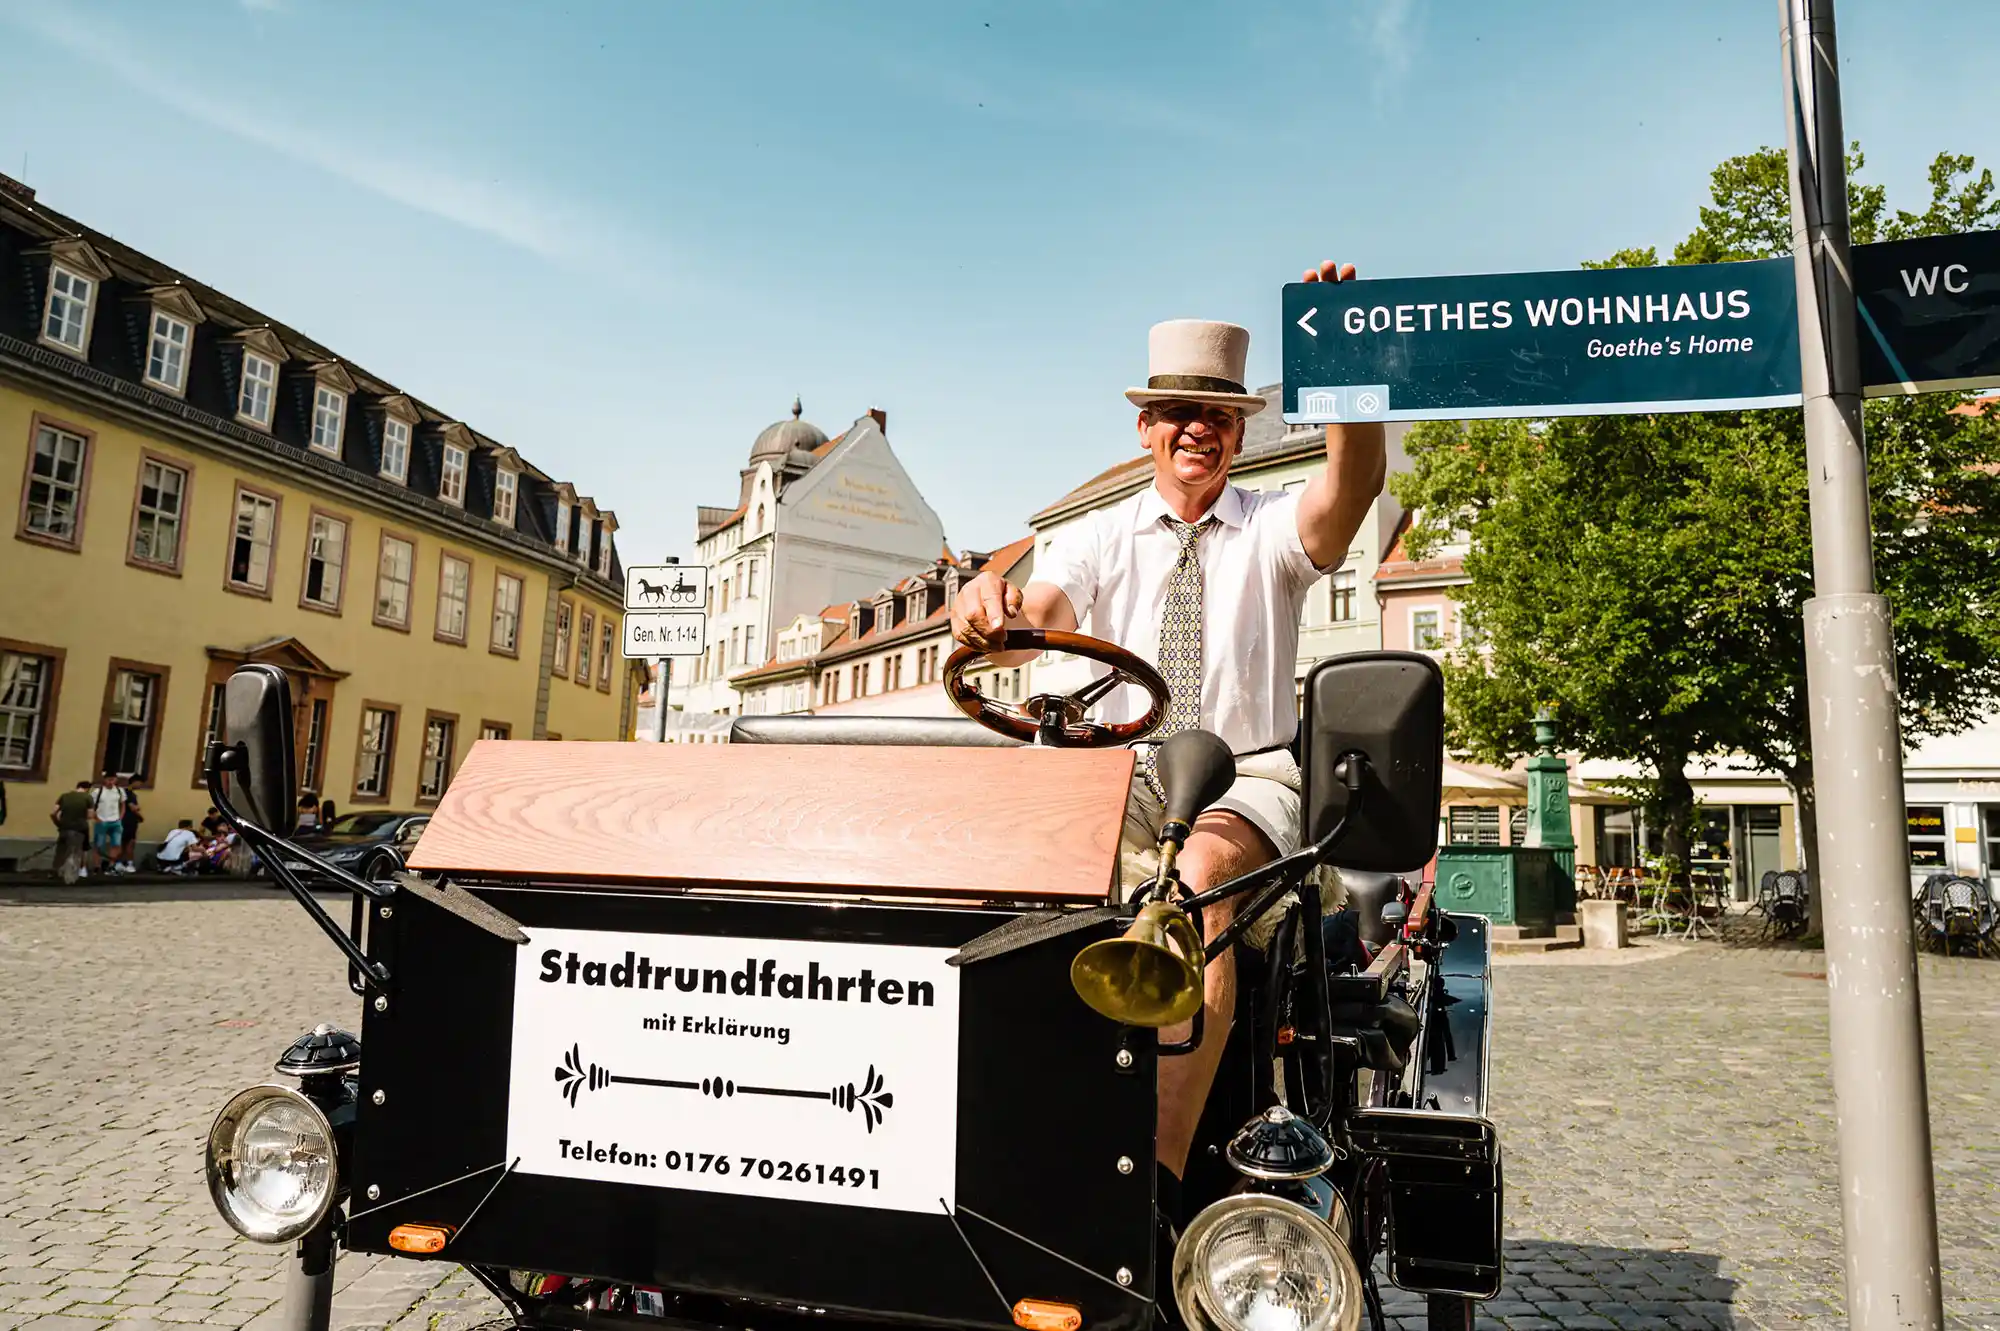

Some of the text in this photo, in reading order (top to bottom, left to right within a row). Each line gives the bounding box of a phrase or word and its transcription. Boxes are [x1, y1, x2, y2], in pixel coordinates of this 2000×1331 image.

[1900, 263, 1970, 298] WC
[1343, 289, 1752, 335] GOETHES WOHNHAUS
[1586, 334, 1755, 359] Goethe's Home
[633, 625, 656, 642] Gen.
[659, 625, 673, 642] Nr.
[539, 949, 935, 1007] Stadtrundfahrten
[642, 1013, 791, 1045] mit Erklärung
[558, 1138, 880, 1190] Telefon: 0176 70261491
